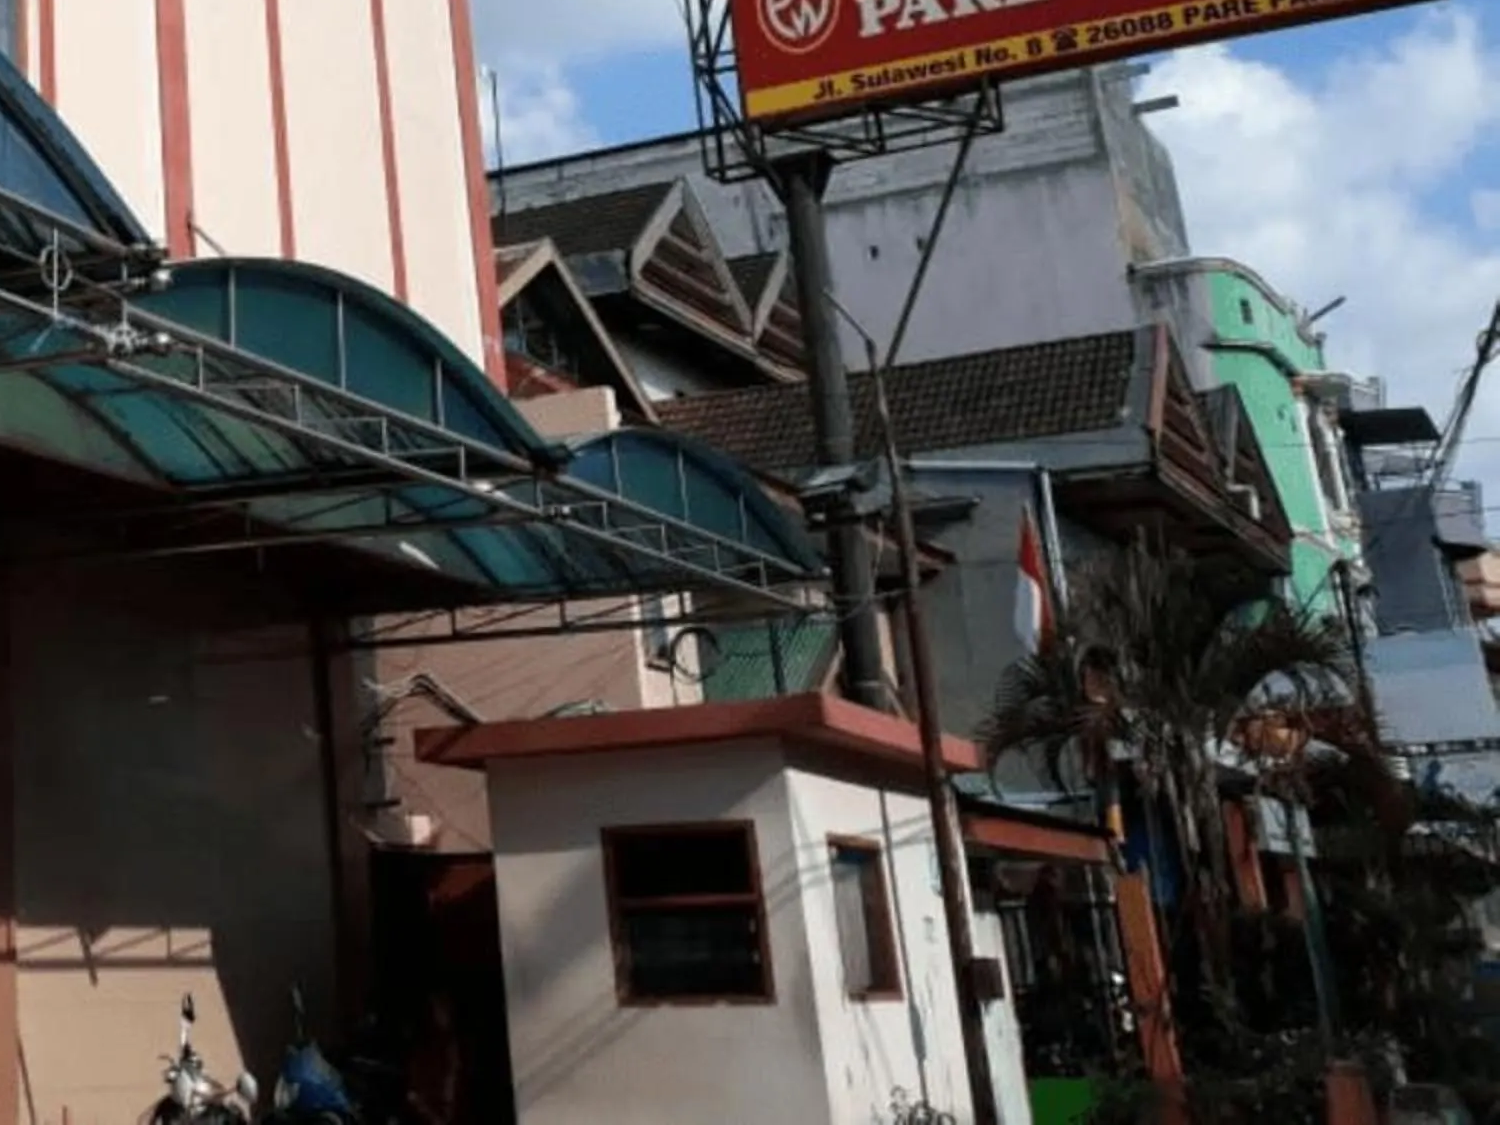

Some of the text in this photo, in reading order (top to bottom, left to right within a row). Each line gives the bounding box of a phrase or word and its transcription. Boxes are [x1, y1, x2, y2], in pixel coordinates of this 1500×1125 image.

[850, 50, 967, 91] Sulawesi
[975, 45, 1018, 68] No.
[1026, 37, 1043, 56] 8
[1088, 11, 1174, 48] 26088
